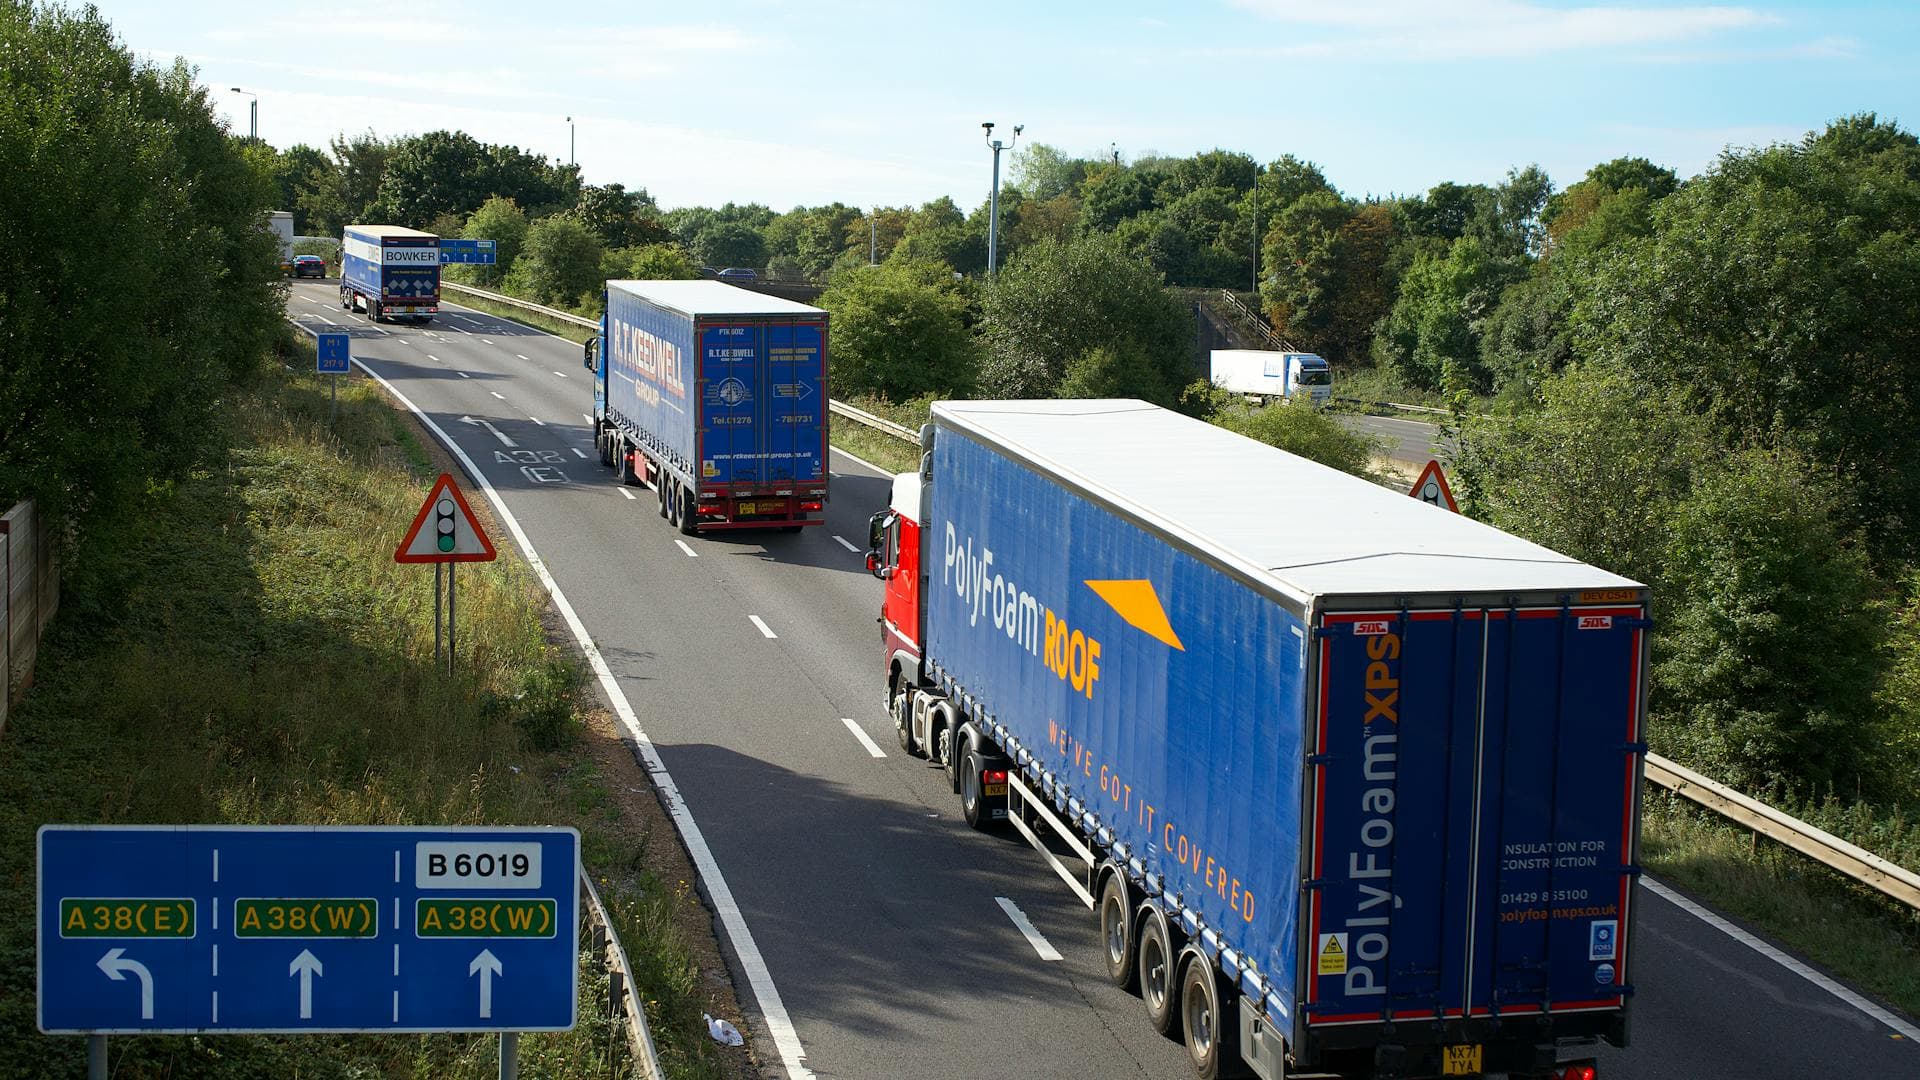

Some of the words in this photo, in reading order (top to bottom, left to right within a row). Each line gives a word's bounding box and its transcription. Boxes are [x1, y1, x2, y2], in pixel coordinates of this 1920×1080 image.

[386, 251, 436, 262] BOWKER
[708, 348, 755, 358] R.T.KEDWELL
[635, 378, 660, 408] GROUP
[1043, 607, 1102, 700] ROOF
[1363, 633, 1401, 725] XPS
[1099, 764, 1132, 812] GOT
[1138, 799, 1155, 833] IT
[1164, 823, 1256, 923] COVERED
[1504, 842, 1577, 855] NSULATON
[1580, 840, 1606, 852] FOR
[1344, 733, 1403, 996] PolyFoam
[1500, 892, 1538, 904] 01429
[1449, 1046, 1476, 1060] NX71
[1450, 1059, 1473, 1073] TYA
